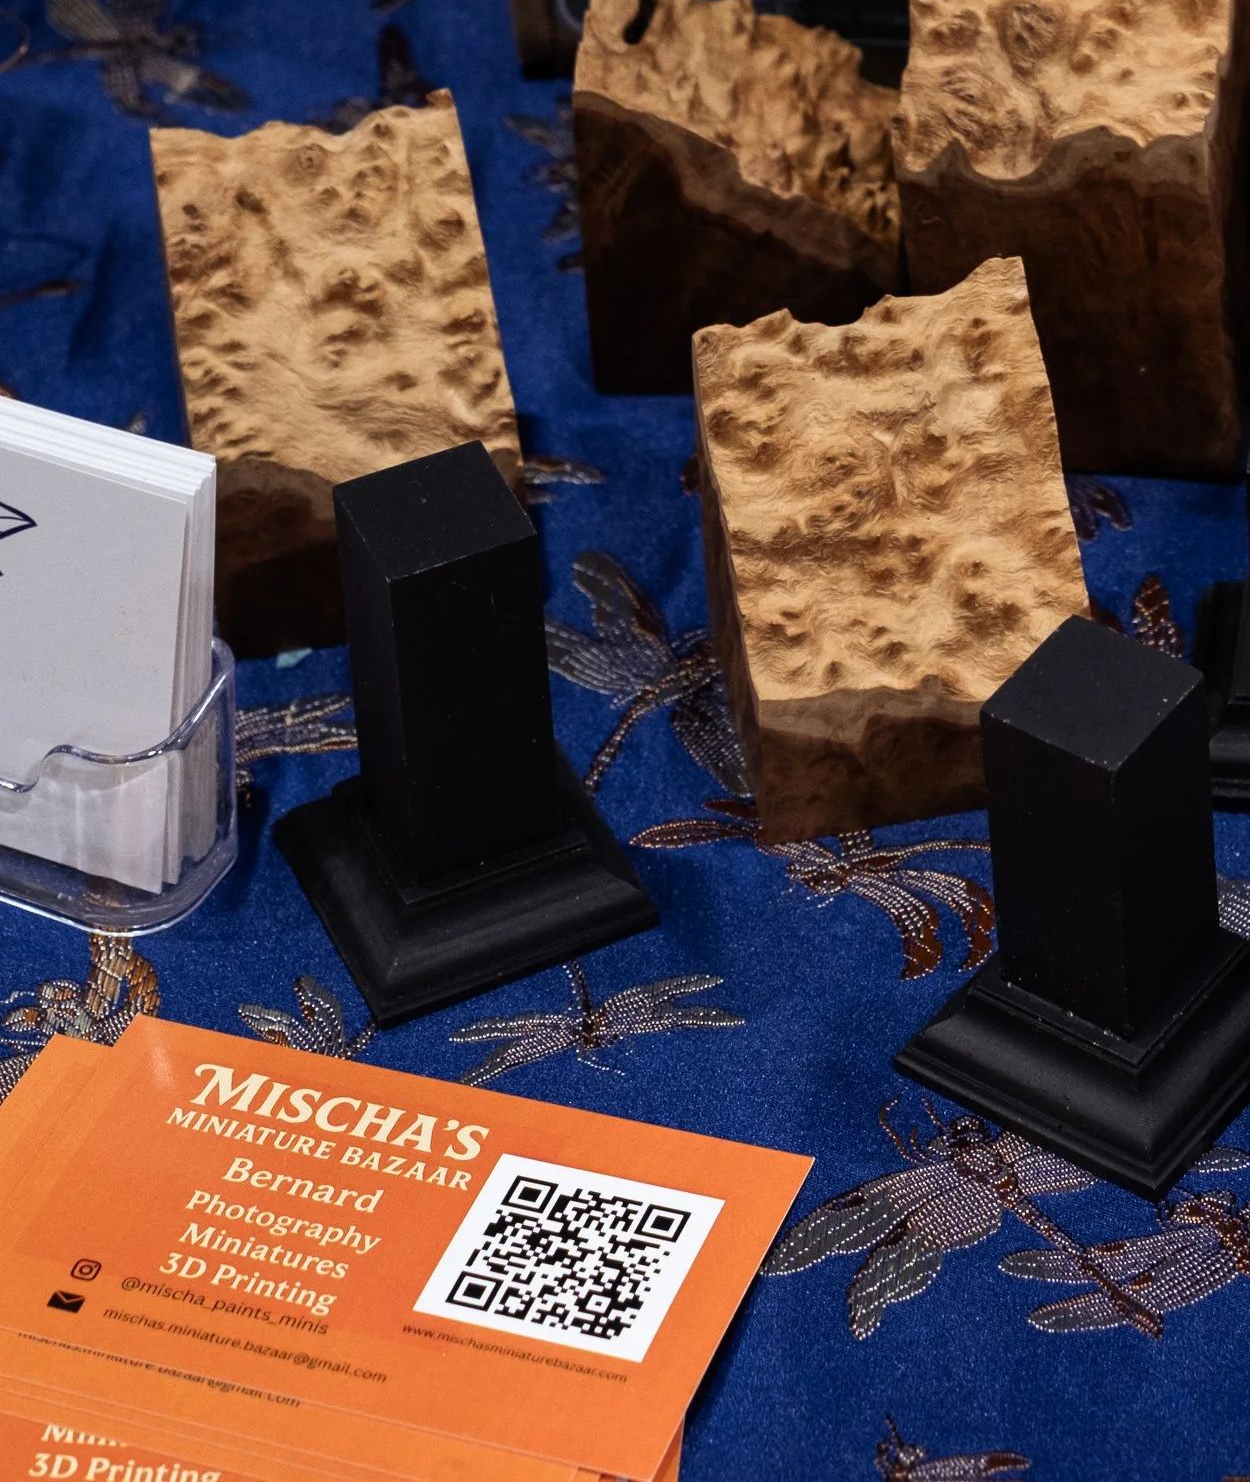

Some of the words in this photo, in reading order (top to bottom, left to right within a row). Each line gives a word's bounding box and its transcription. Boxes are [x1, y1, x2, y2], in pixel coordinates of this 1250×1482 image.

[166, 1107, 337, 1160] MINIATURE
[340, 1146, 472, 1192] BAZAAR
[221, 1157, 384, 1213] Bernard
[178, 1222, 349, 1279] Miniatures
[185, 1189, 382, 1255] Photography
[121, 1276, 329, 1335] @mischa_paints_minis
[159, 1252, 206, 1280] 3D
[211, 1263, 338, 1317] Printing
[103, 1306, 388, 1384] mischas.miniature.bazaar@gmail.com
[402, 1324, 628, 1383] www.mischasminiaturebazaar.com
[28, 1453, 78, 1478] 3D
